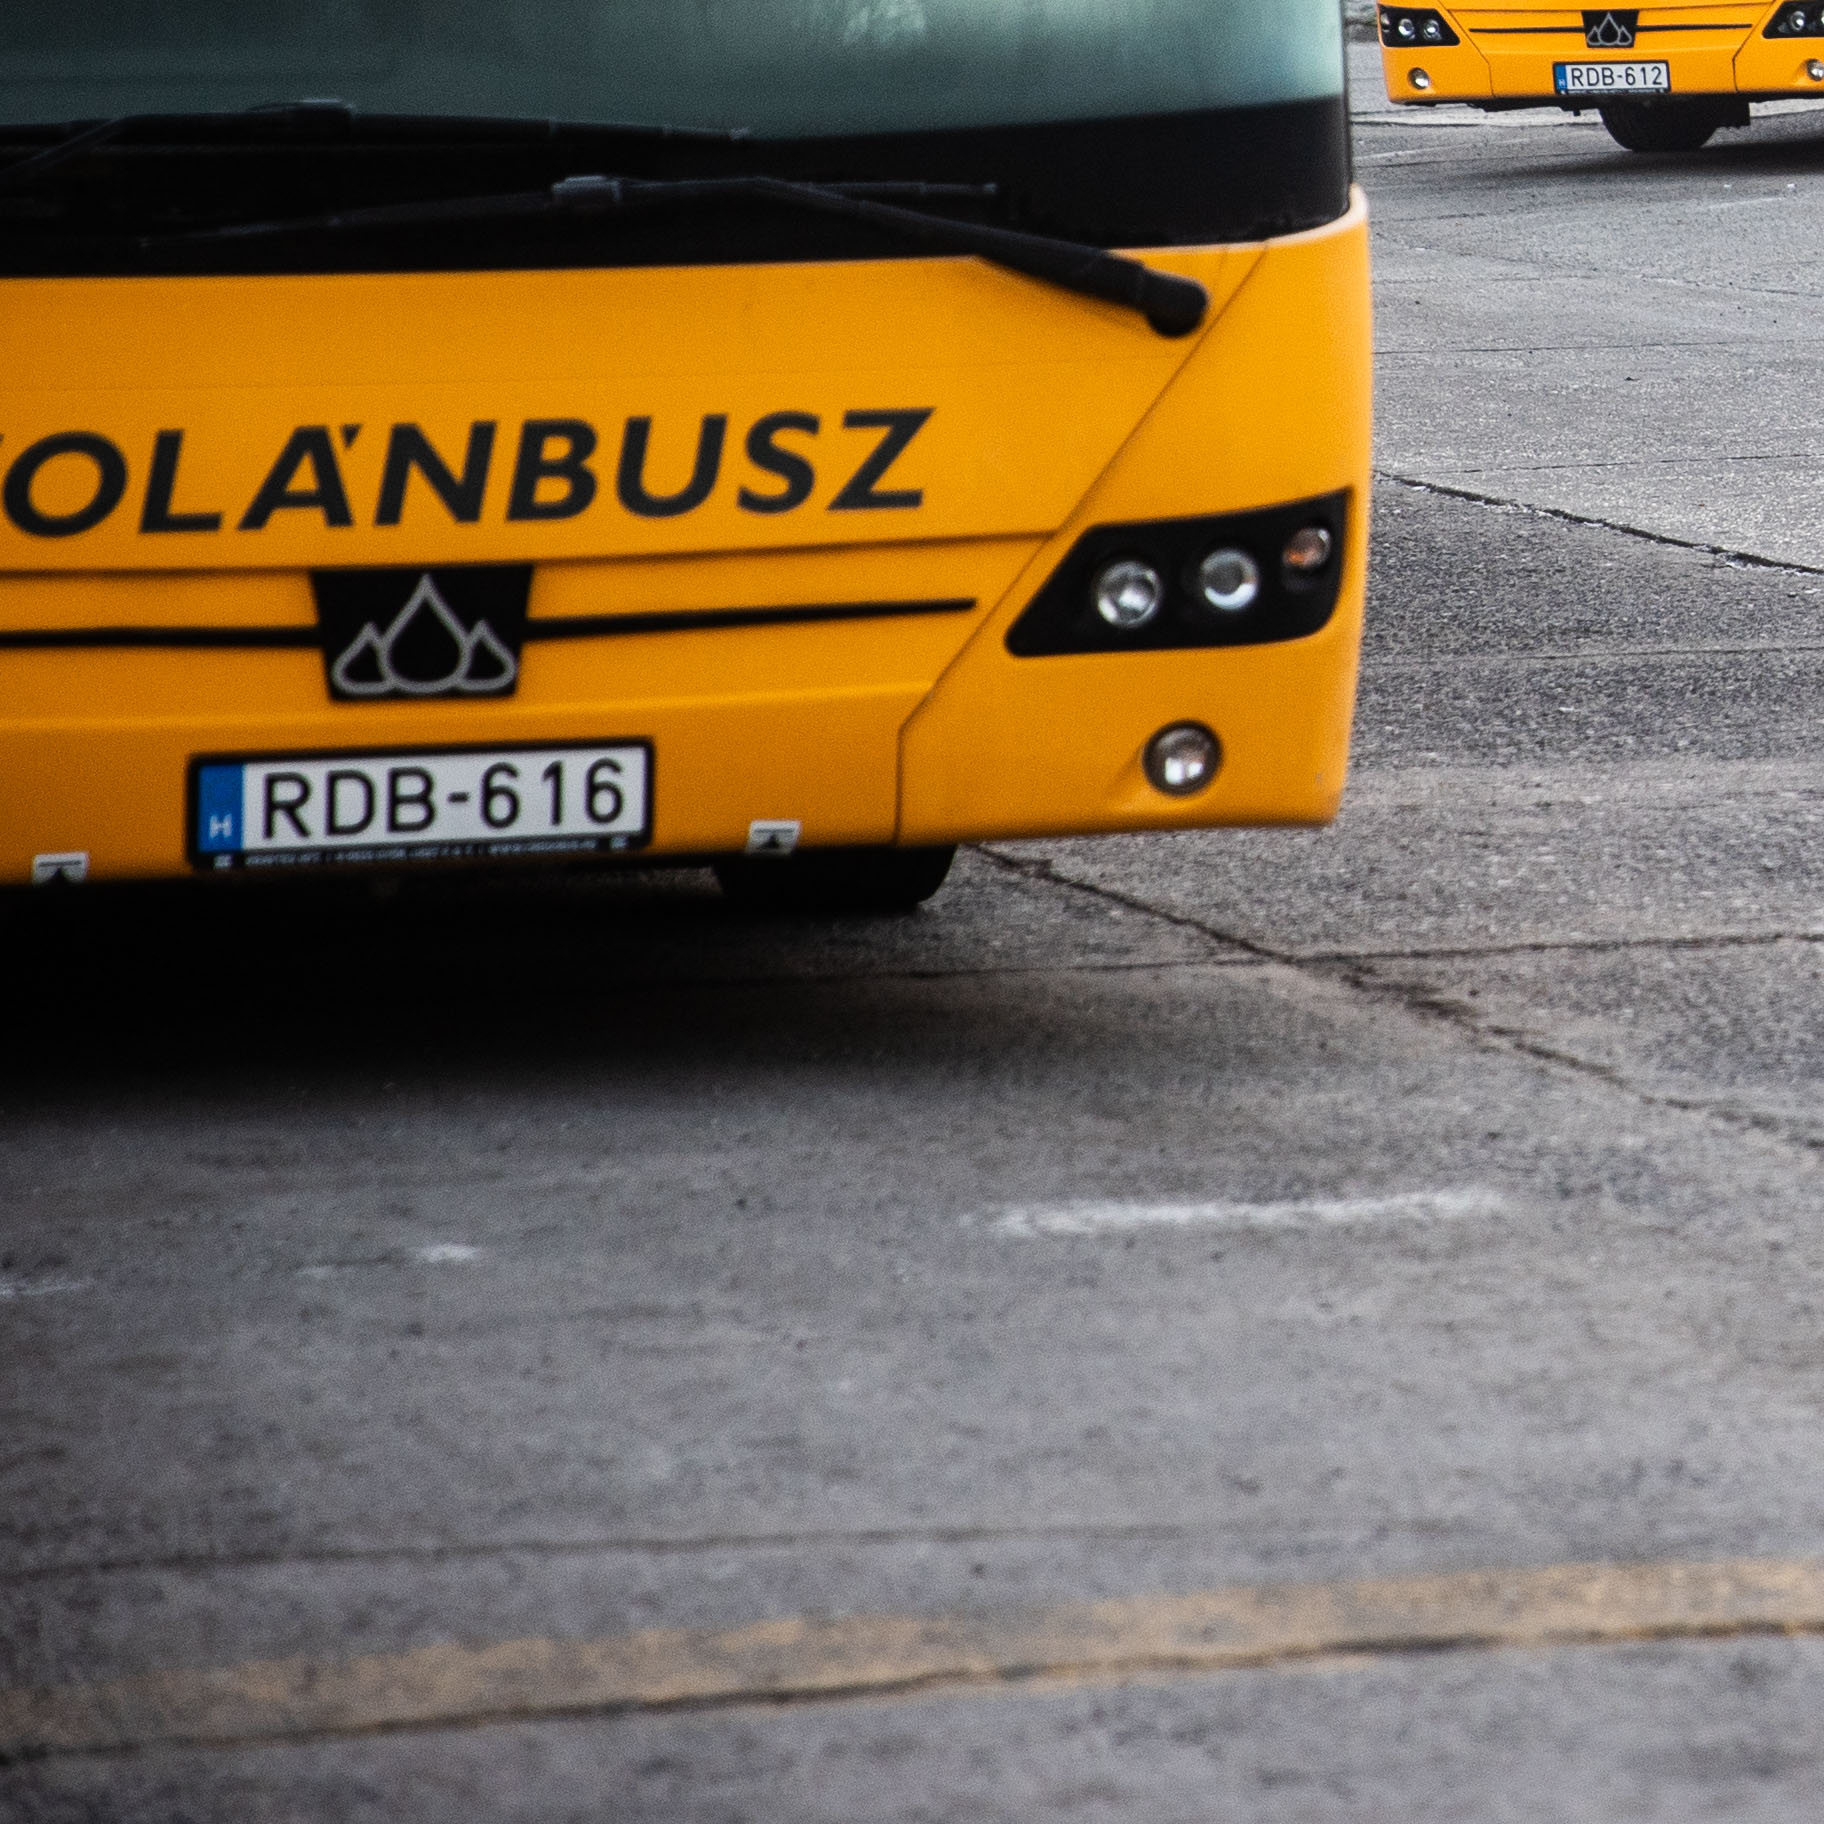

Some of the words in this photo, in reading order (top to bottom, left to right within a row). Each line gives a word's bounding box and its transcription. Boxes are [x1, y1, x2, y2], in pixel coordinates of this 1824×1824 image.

[1571, 66, 1663, 87] RDB-612
[0, 406, 938, 539] OLÁNBUSZ
[209, 813, 232, 841] H
[262, 757, 624, 840] RDB-616
